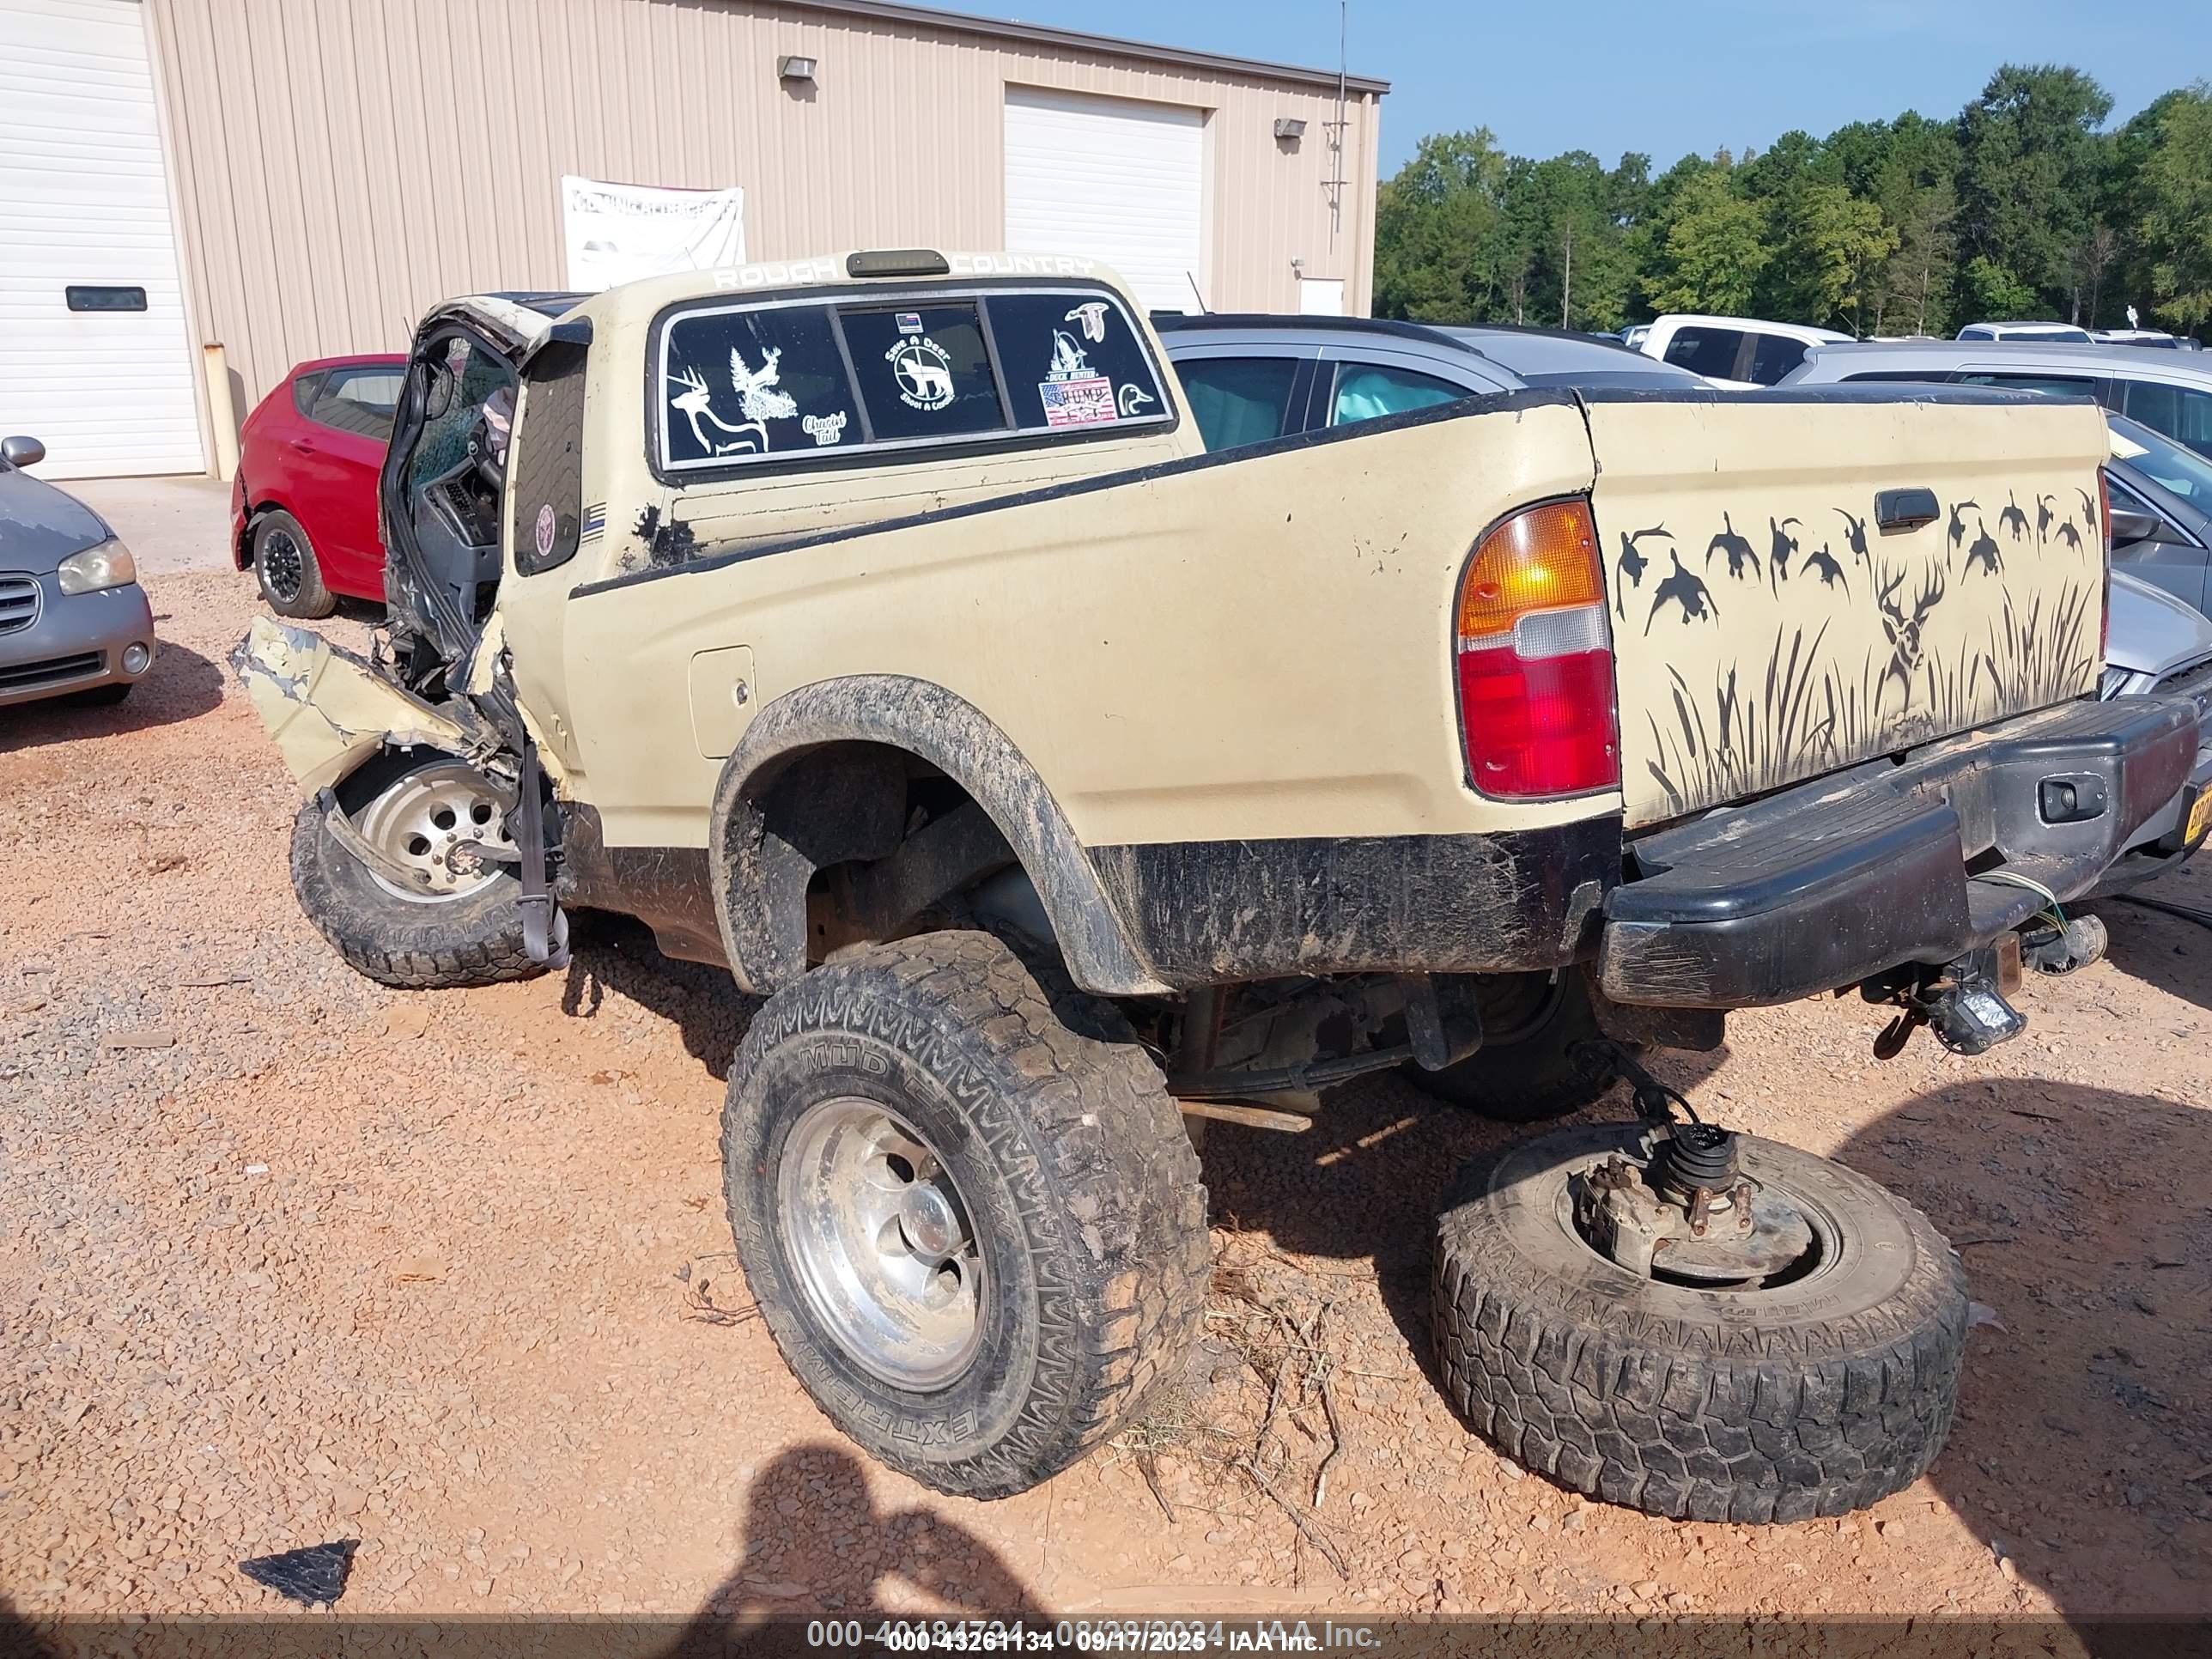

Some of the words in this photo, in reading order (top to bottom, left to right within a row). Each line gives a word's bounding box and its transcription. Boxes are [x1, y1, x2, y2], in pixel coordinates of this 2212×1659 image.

[713, 258, 838, 289] ROUGH
[952, 252, 1095, 274] COUNTRY
[884, 339, 908, 362] Save
[909, 335, 920, 345] A
[923, 337, 952, 362] Deer
[1051, 388, 1103, 405] TRUMP
[815, 428, 840, 445] Tail
[799, 1043, 889, 1076] MUD
[775, 1310, 978, 1444] EXTREME
